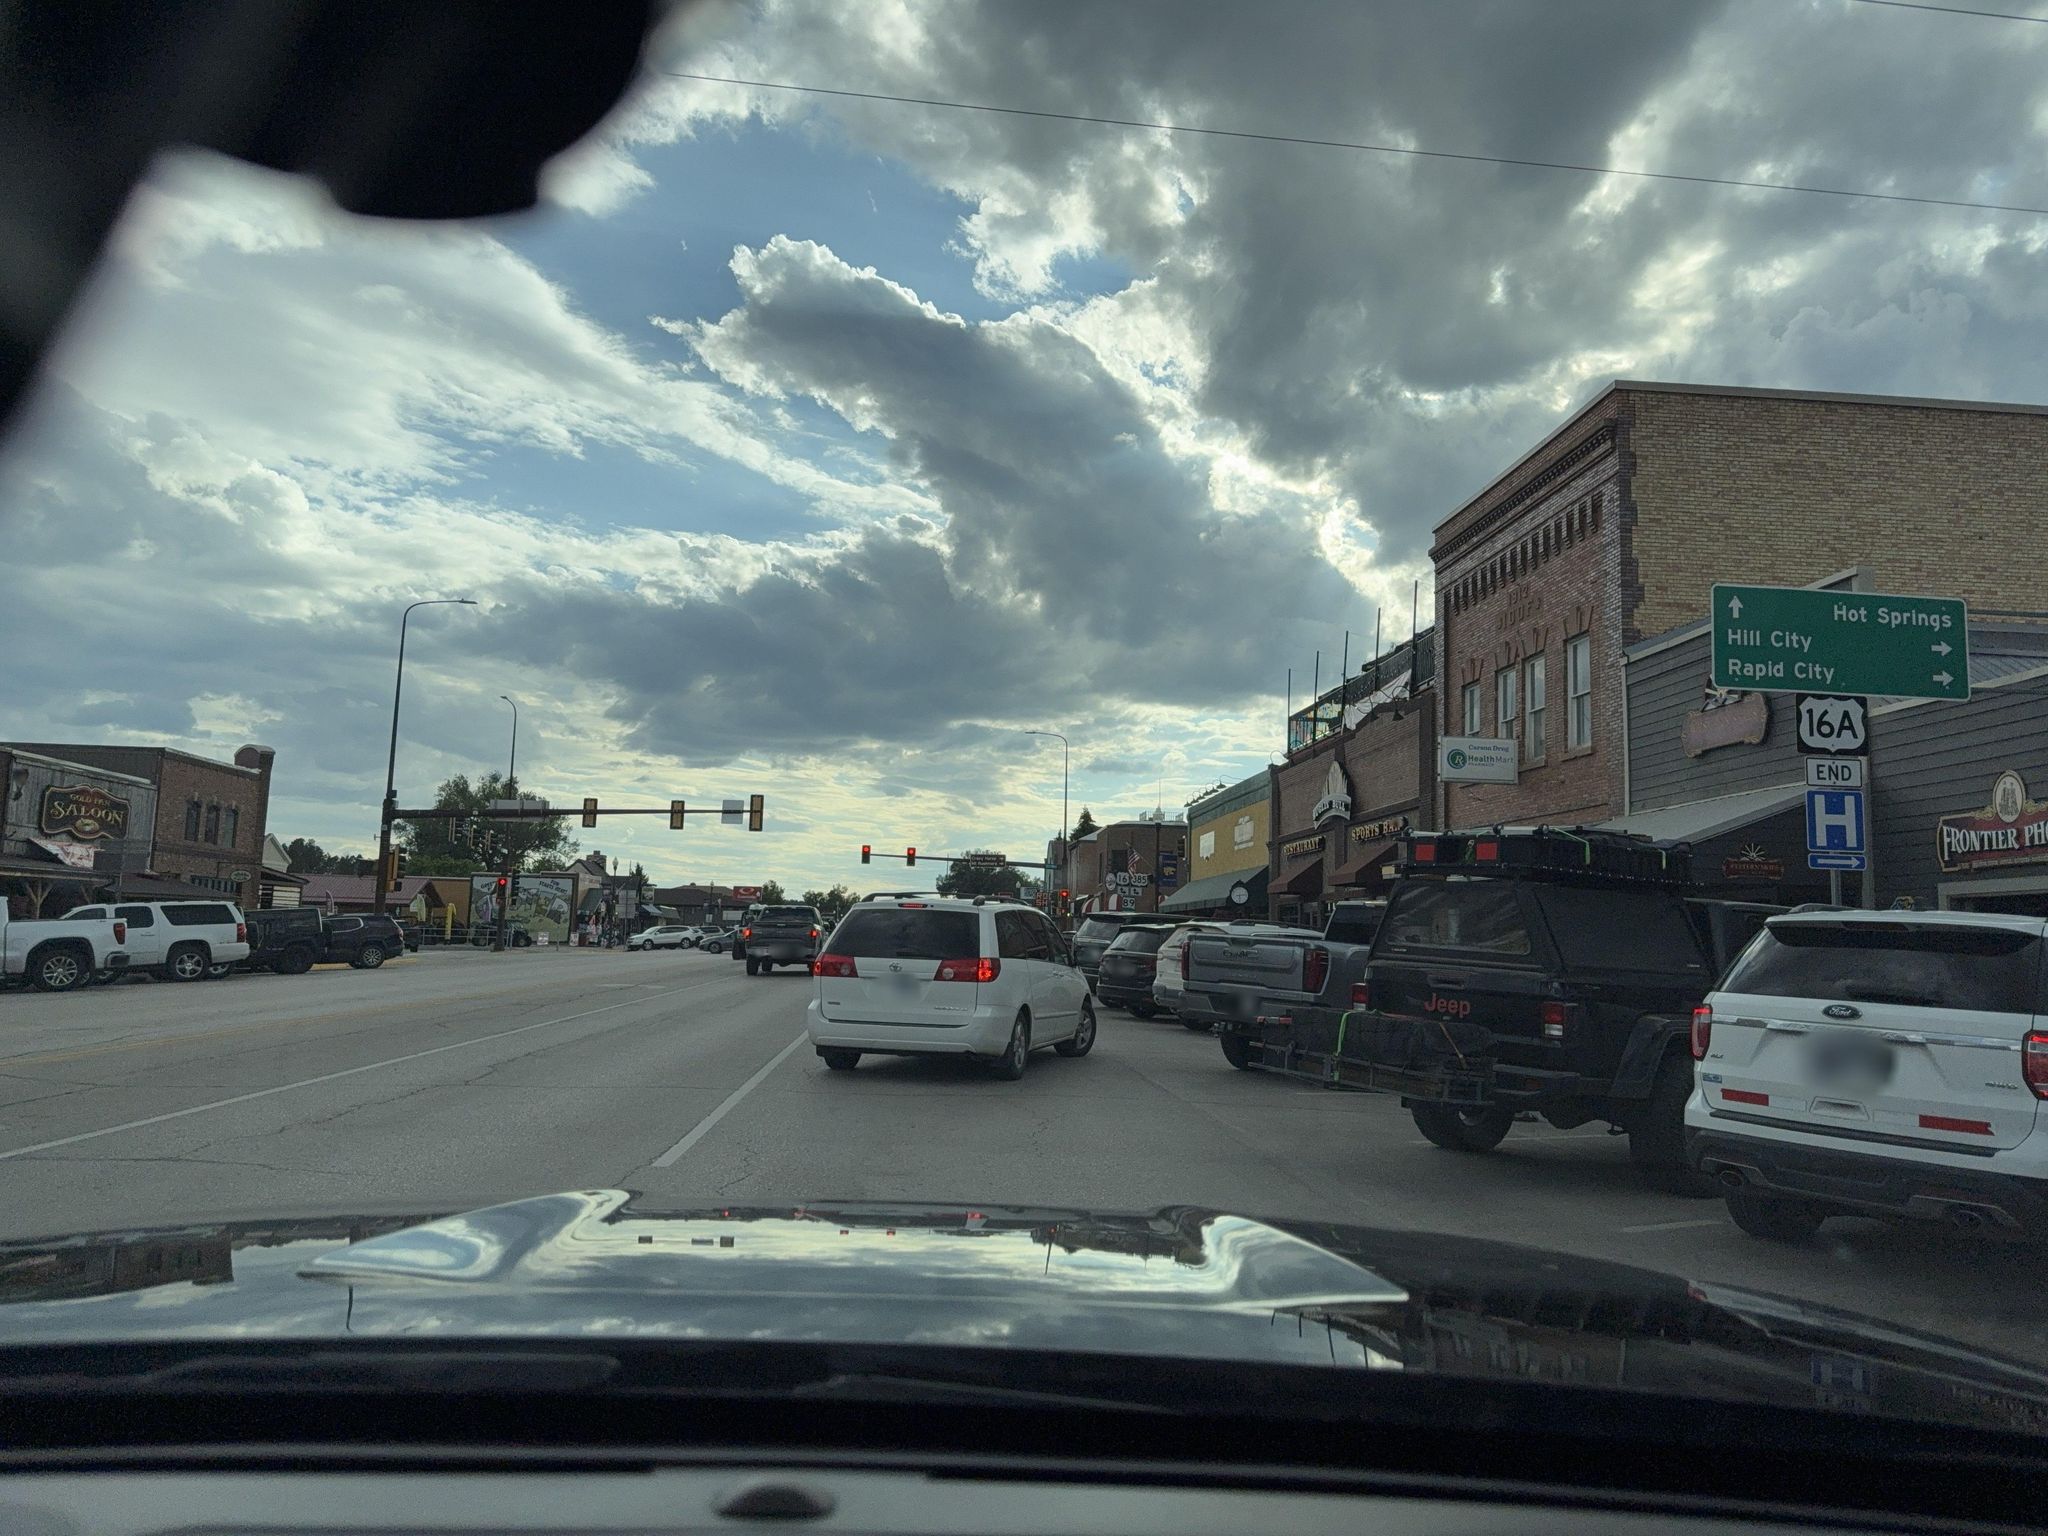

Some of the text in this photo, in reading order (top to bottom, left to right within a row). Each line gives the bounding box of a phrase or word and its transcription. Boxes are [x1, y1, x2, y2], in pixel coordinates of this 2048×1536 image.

[1833, 604, 1953, 632] Hot Springs
[1728, 629, 1812, 653] Hill City
[1728, 659, 1834, 684] Rapid City
[1806, 708, 1859, 740] 16A
[1816, 764, 1852, 782] END
[50, 800, 124, 825] SALOON
[1814, 794, 1858, 848] H
[1352, 822, 1380, 841] SPORTS
[1942, 826, 2019, 861] FRONTIER
[1118, 873, 1128, 884] 16
[1123, 899, 1135, 907] 89
[1424, 992, 1471, 1018] Jeep
[1828, 1006, 1852, 1016] Ford
